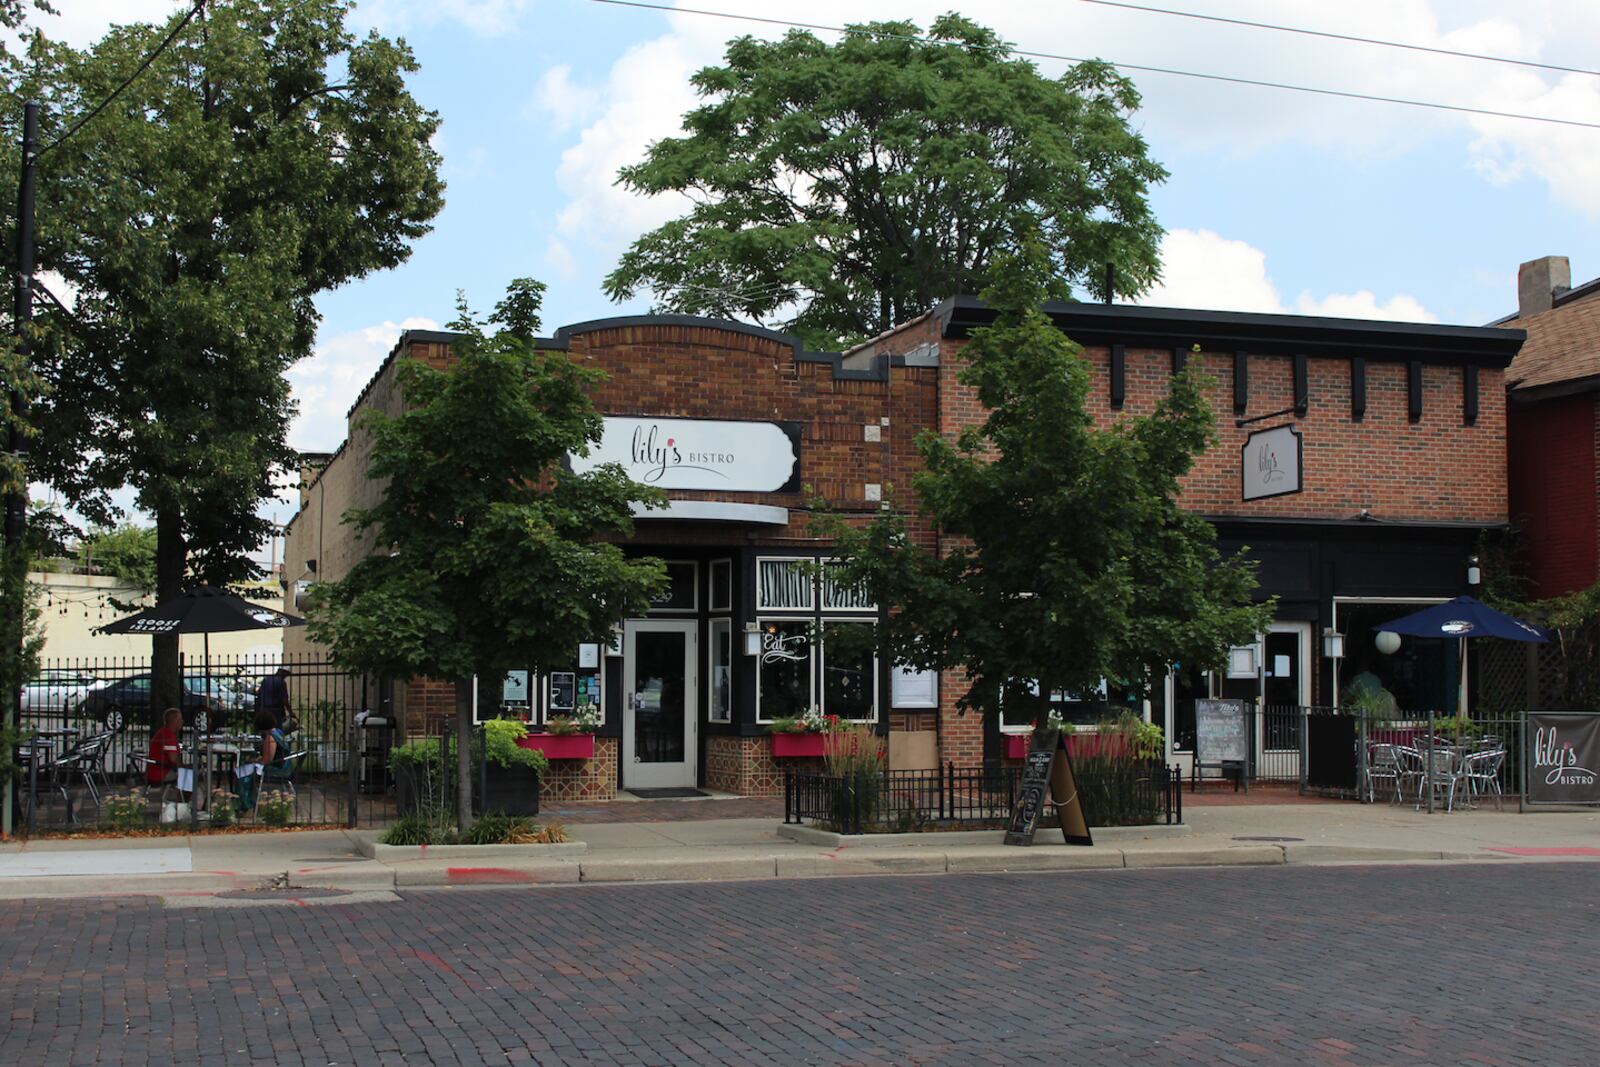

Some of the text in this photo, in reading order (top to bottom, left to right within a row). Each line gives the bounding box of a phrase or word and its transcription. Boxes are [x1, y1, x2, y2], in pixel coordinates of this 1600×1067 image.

[631, 425, 735, 483] lily's BISTRO
[137, 618, 181, 627] GOOSE
[1534, 726, 1577, 785] lily's
[1560, 776, 1594, 785] BISTRO
